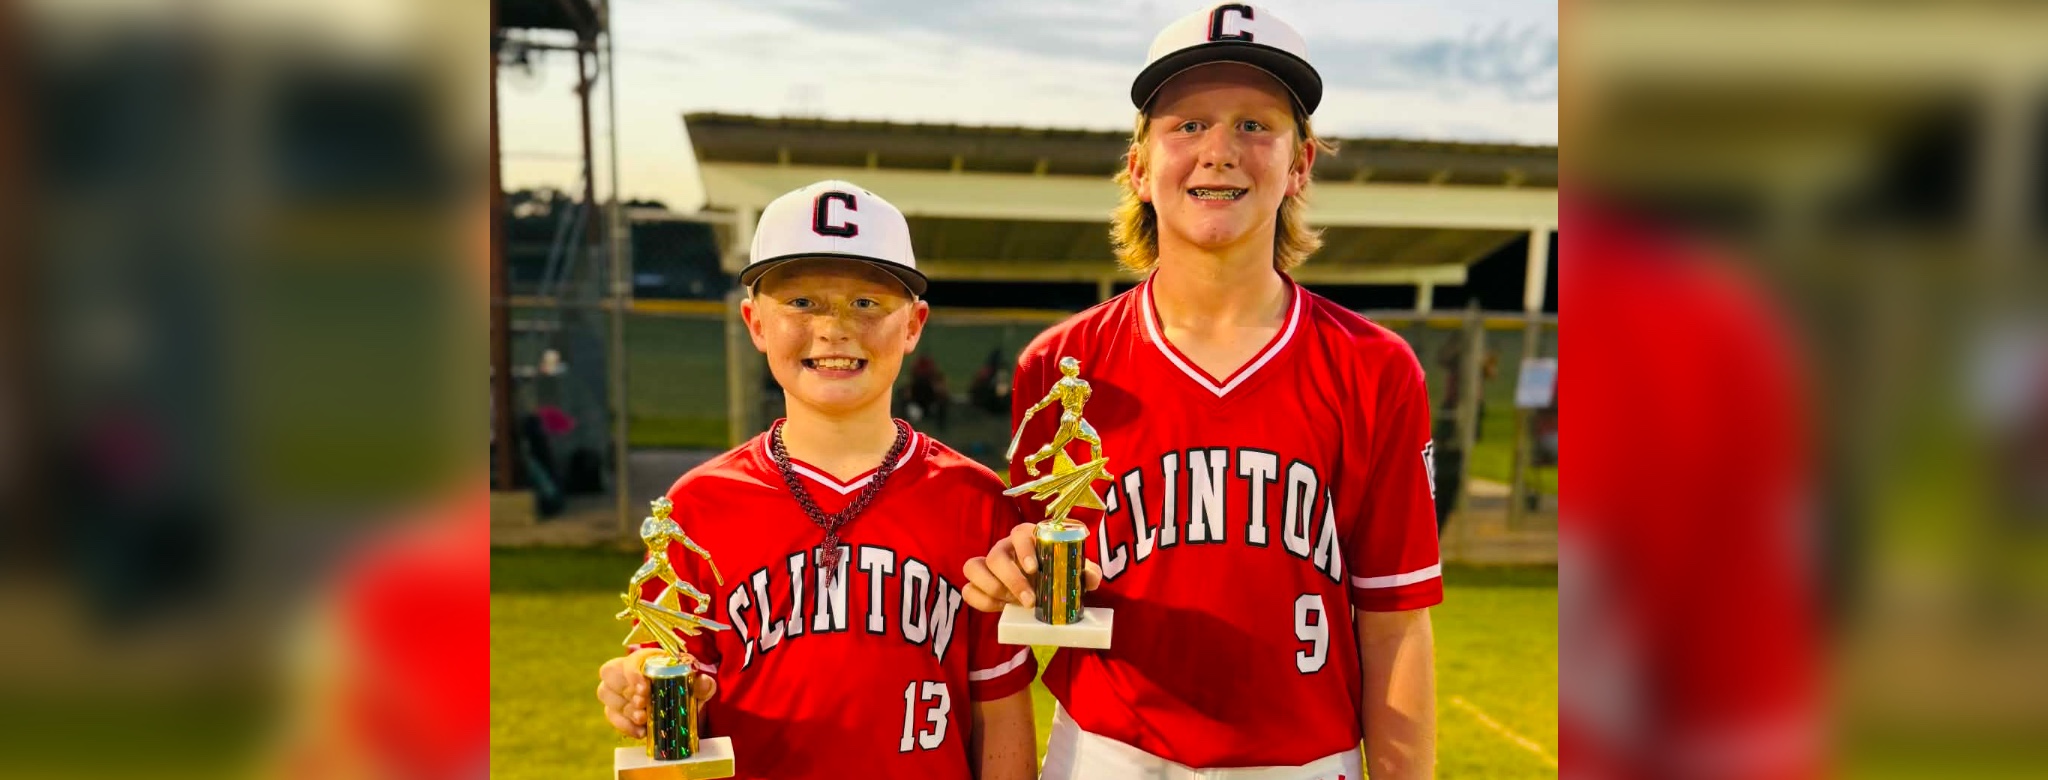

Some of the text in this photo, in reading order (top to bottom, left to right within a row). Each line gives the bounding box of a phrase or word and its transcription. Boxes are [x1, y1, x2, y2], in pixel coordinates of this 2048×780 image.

[1208, 4, 1254, 42] C
[812, 191, 859, 238] C
[727, 543, 963, 672] CLINTON
[1295, 593, 1329, 674] 9
[899, 681, 951, 753] 13
